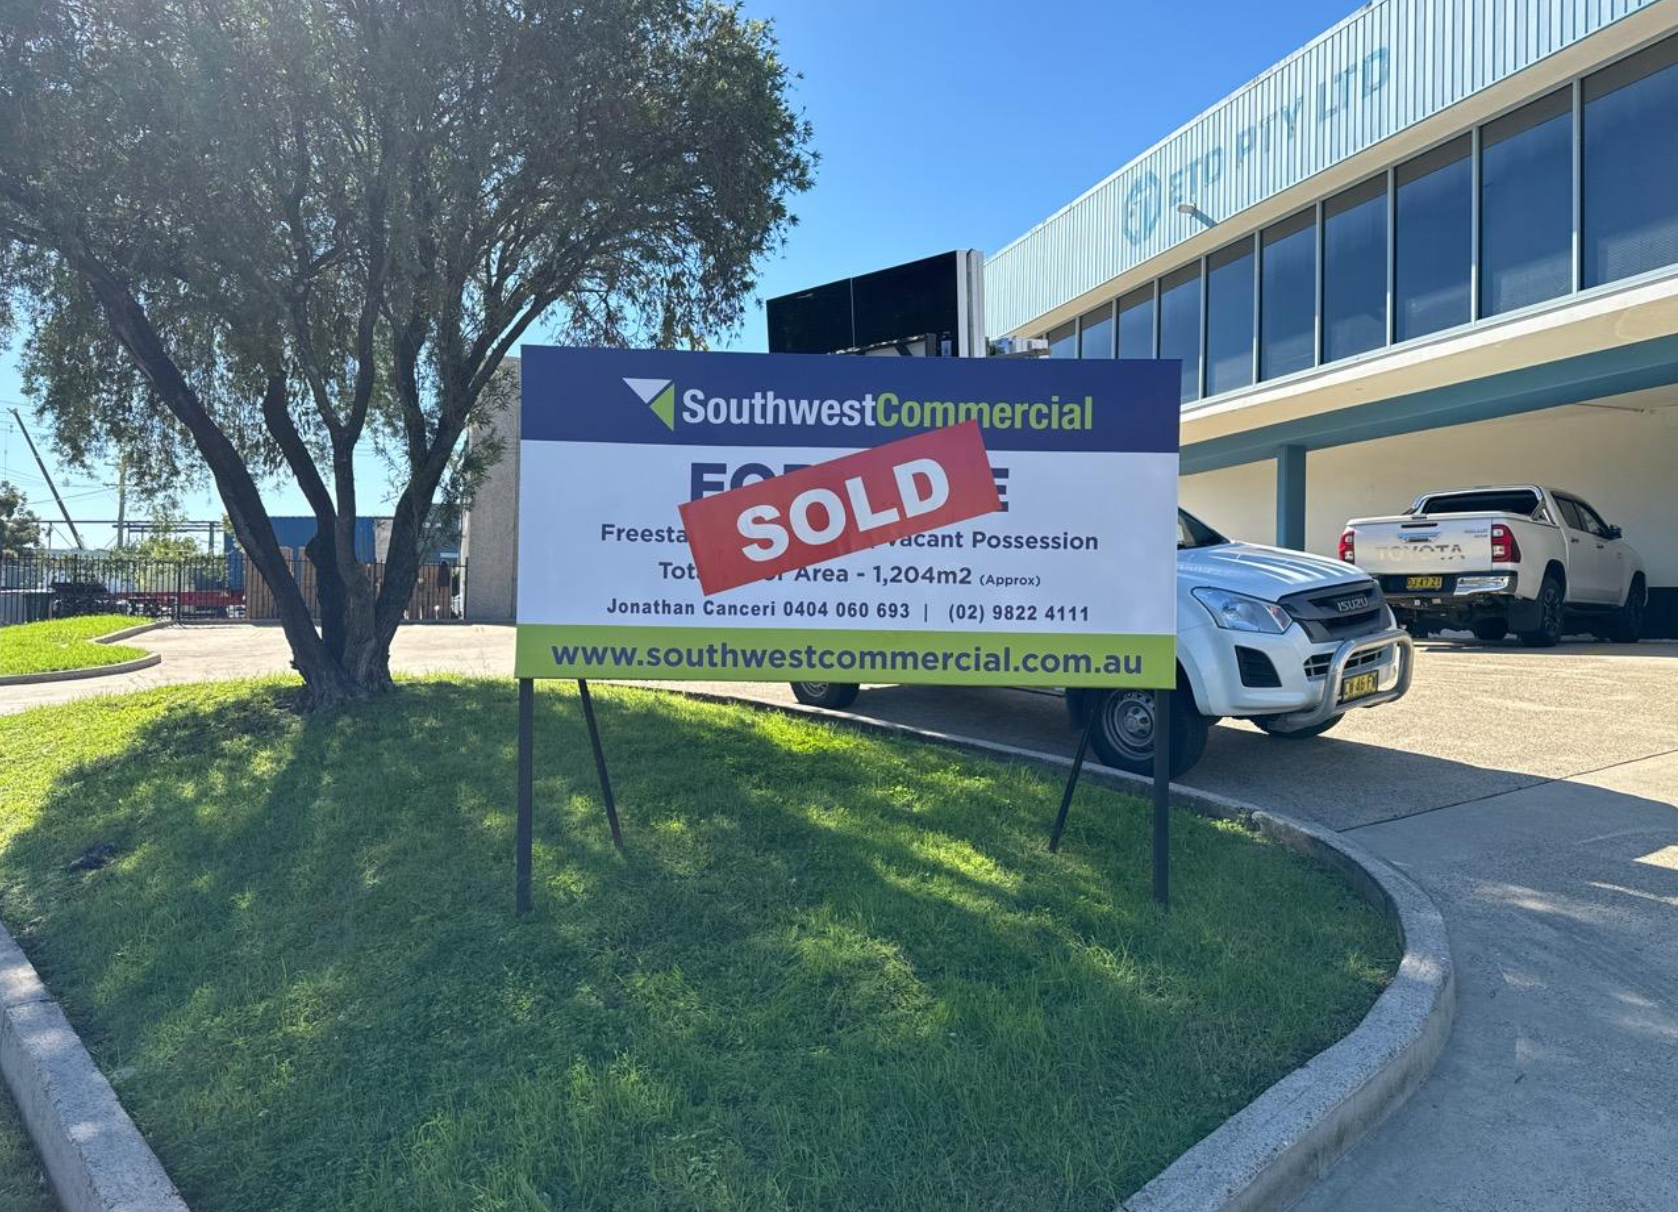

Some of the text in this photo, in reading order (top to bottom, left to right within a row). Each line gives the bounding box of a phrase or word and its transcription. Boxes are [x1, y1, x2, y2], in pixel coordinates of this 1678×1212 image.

[1236, 95, 1303, 168] PTY
[1319, 47, 1389, 122] LTD
[682, 389, 1093, 430] SouthwestCommercial
[736, 457, 950, 563] SOLD
[601, 523, 689, 543] Freesta
[972, 531, 1099, 551] Possession
[658, 561, 699, 580] Tot
[794, 566, 849, 582] Area
[873, 565, 972, 586] 1,204m2
[980, 575, 1041, 587] (Approx)
[607, 599, 695, 616] Jonathan
[703, 600, 776, 617] Canceri
[784, 601, 828, 618] 0404
[836, 602, 869, 618] 060
[877, 603, 910, 618] 693
[949, 604, 985, 624] (02)
[993, 606, 1038, 621] 9822
[1045, 606, 1090, 622] 4111
[1337, 597, 1369, 611] ISUZU
[551, 643, 1143, 675] www.southwestcommercial.com.au
